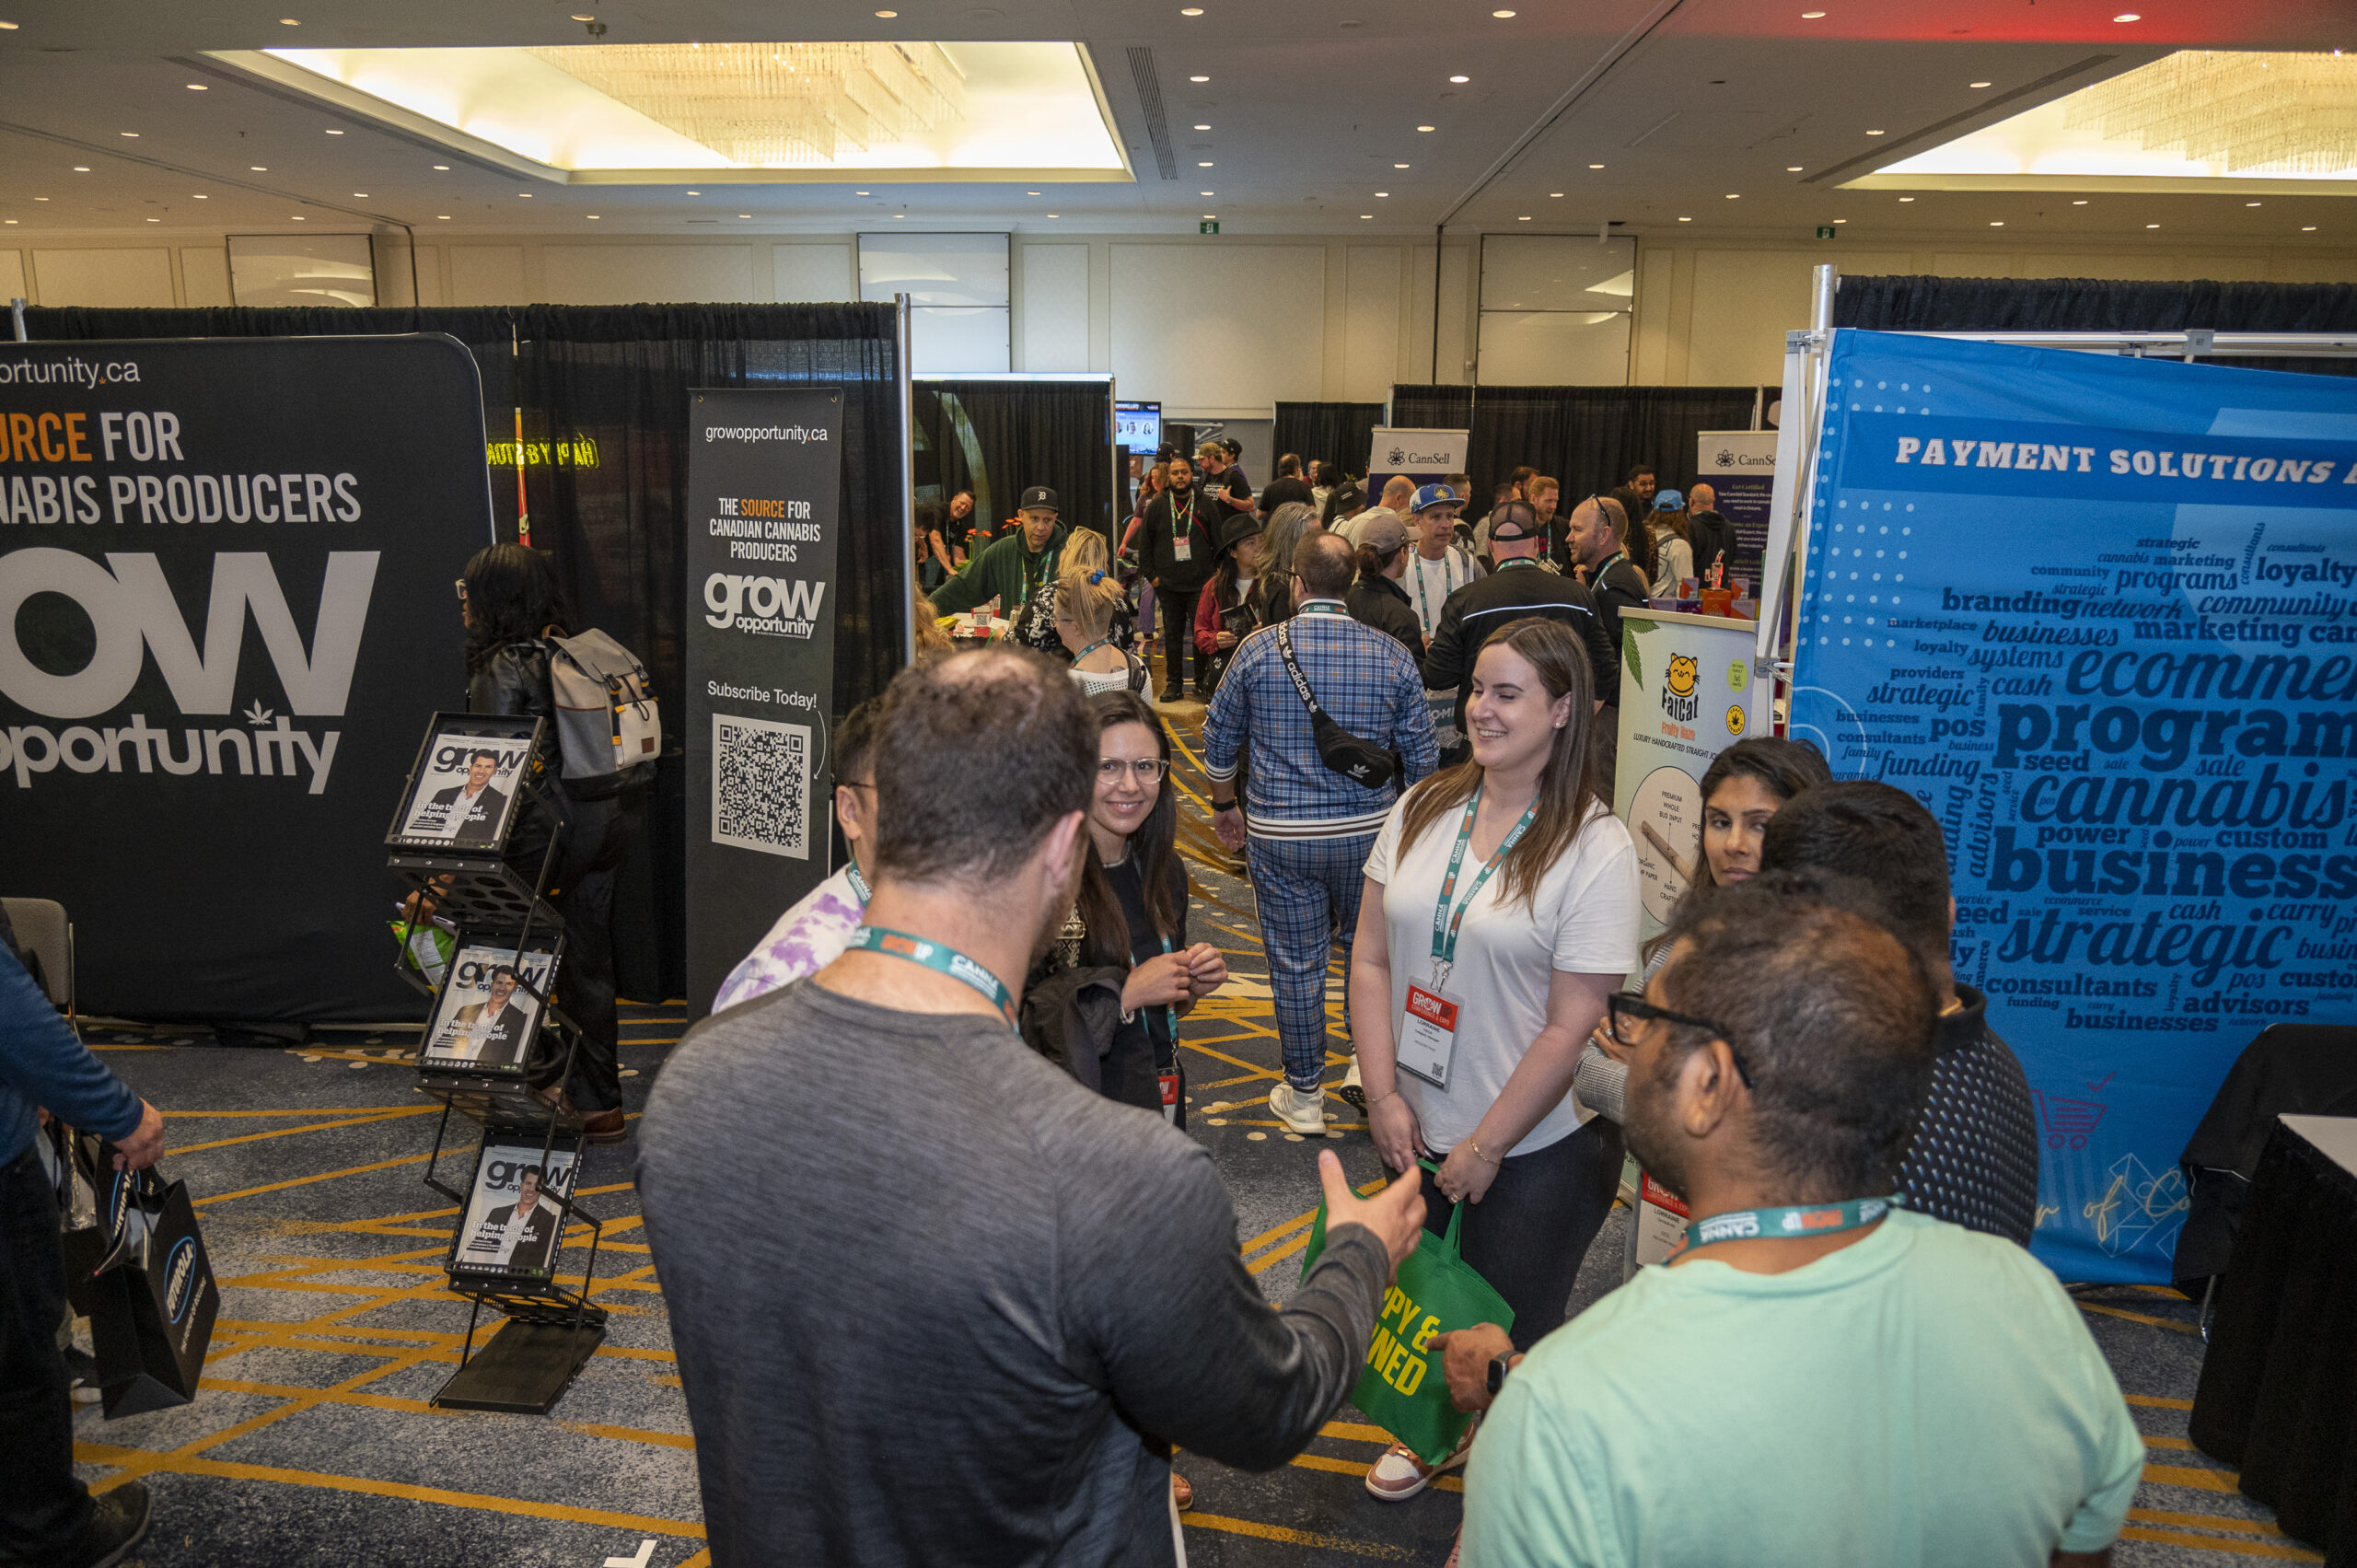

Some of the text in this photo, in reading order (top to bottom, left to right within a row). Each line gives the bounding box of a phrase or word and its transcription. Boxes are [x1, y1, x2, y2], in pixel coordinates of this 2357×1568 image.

[100, 411, 184, 461] FOR
[705, 424, 828, 444] growopportunity.ca
[1408, 452, 1451, 465] CannSell
[1896, 436, 2096, 472] PAYMENT
[2109, 448, 2336, 484] SOLUTIONS
[109, 472, 362, 524] PRODUCERS
[718, 497, 811, 519] THE SOURCE FOR
[709, 517, 821, 542] CANADIAN CANNABIS
[730, 540, 797, 563] PRODUCERS
[2136, 538, 2200, 552] strategic
[2240, 522, 2266, 586] consultants
[2097, 552, 2149, 563] cannabis
[2153, 552, 2236, 571] marketing
[2030, 564, 2111, 580] community
[2115, 569, 2238, 597] programs
[2255, 556, 2357, 588] loyalty
[704, 573, 827, 630] grow
[2051, 582, 2108, 598] strategic
[1941, 586, 2082, 621] branding
[2080, 598, 2185, 620] network
[2197, 590, 2349, 622] community
[736, 616, 815, 640] opportunity
[1982, 619, 2119, 646] businesses
[2133, 614, 2305, 649] marketing
[1913, 639, 1970, 656] loyalty
[1967, 645, 2064, 674] systems
[1287, 661, 1312, 701] adidas
[1889, 666, 1966, 681] providers
[1991, 673, 2053, 696] cash
[707, 679, 818, 712] Subscribe Today!
[1661, 685, 1700, 722] FatCat
[1865, 681, 1975, 713] strategic
[1975, 677, 1990, 717] family
[1835, 708, 1920, 724] businesses
[1836, 730, 1927, 745] consultants
[1928, 717, 1987, 743] pos
[0, 714, 342, 795] pportunity
[1633, 732, 1710, 759] LUXURY HANDCRAFTED STRAIGHT
[1840, 744, 1882, 761] family
[1947, 738, 1995, 752] business
[433, 746, 528, 772] grw
[1877, 749, 1981, 785] funding
[2023, 749, 2090, 772] seed
[2102, 757, 2130, 771] sale
[2194, 754, 2247, 777] sale
[428, 802, 444, 811] the
[472, 805, 483, 813] of
[1661, 790, 1683, 803] PREMIUM
[1663, 801, 1680, 813] WHOLE
[2020, 761, 2347, 830] cannabis
[1967, 772, 1999, 877] advisors
[2035, 826, 2131, 848] power
[2215, 828, 2328, 849] custom
[1986, 826, 2357, 900] business
[1956, 900, 2009, 924] eed
[2076, 904, 2132, 917] service
[2168, 900, 2222, 921] cash
[2266, 902, 2338, 929] carry
[1951, 926, 1976, 937] ash
[1996, 907, 2293, 988] strategic
[1985, 972, 2158, 997] consultants
[2225, 971, 2267, 994] pos
[2006, 995, 2061, 1011] funding
[2182, 990, 2311, 1016] advisors
[2063, 1007, 2220, 1031] businesses
[485, 1160, 572, 1191] grw
[483, 1221, 499, 1231] the
[1699, 1220, 1760, 1243] CANNA
[1411, 1314, 1442, 1355] &
